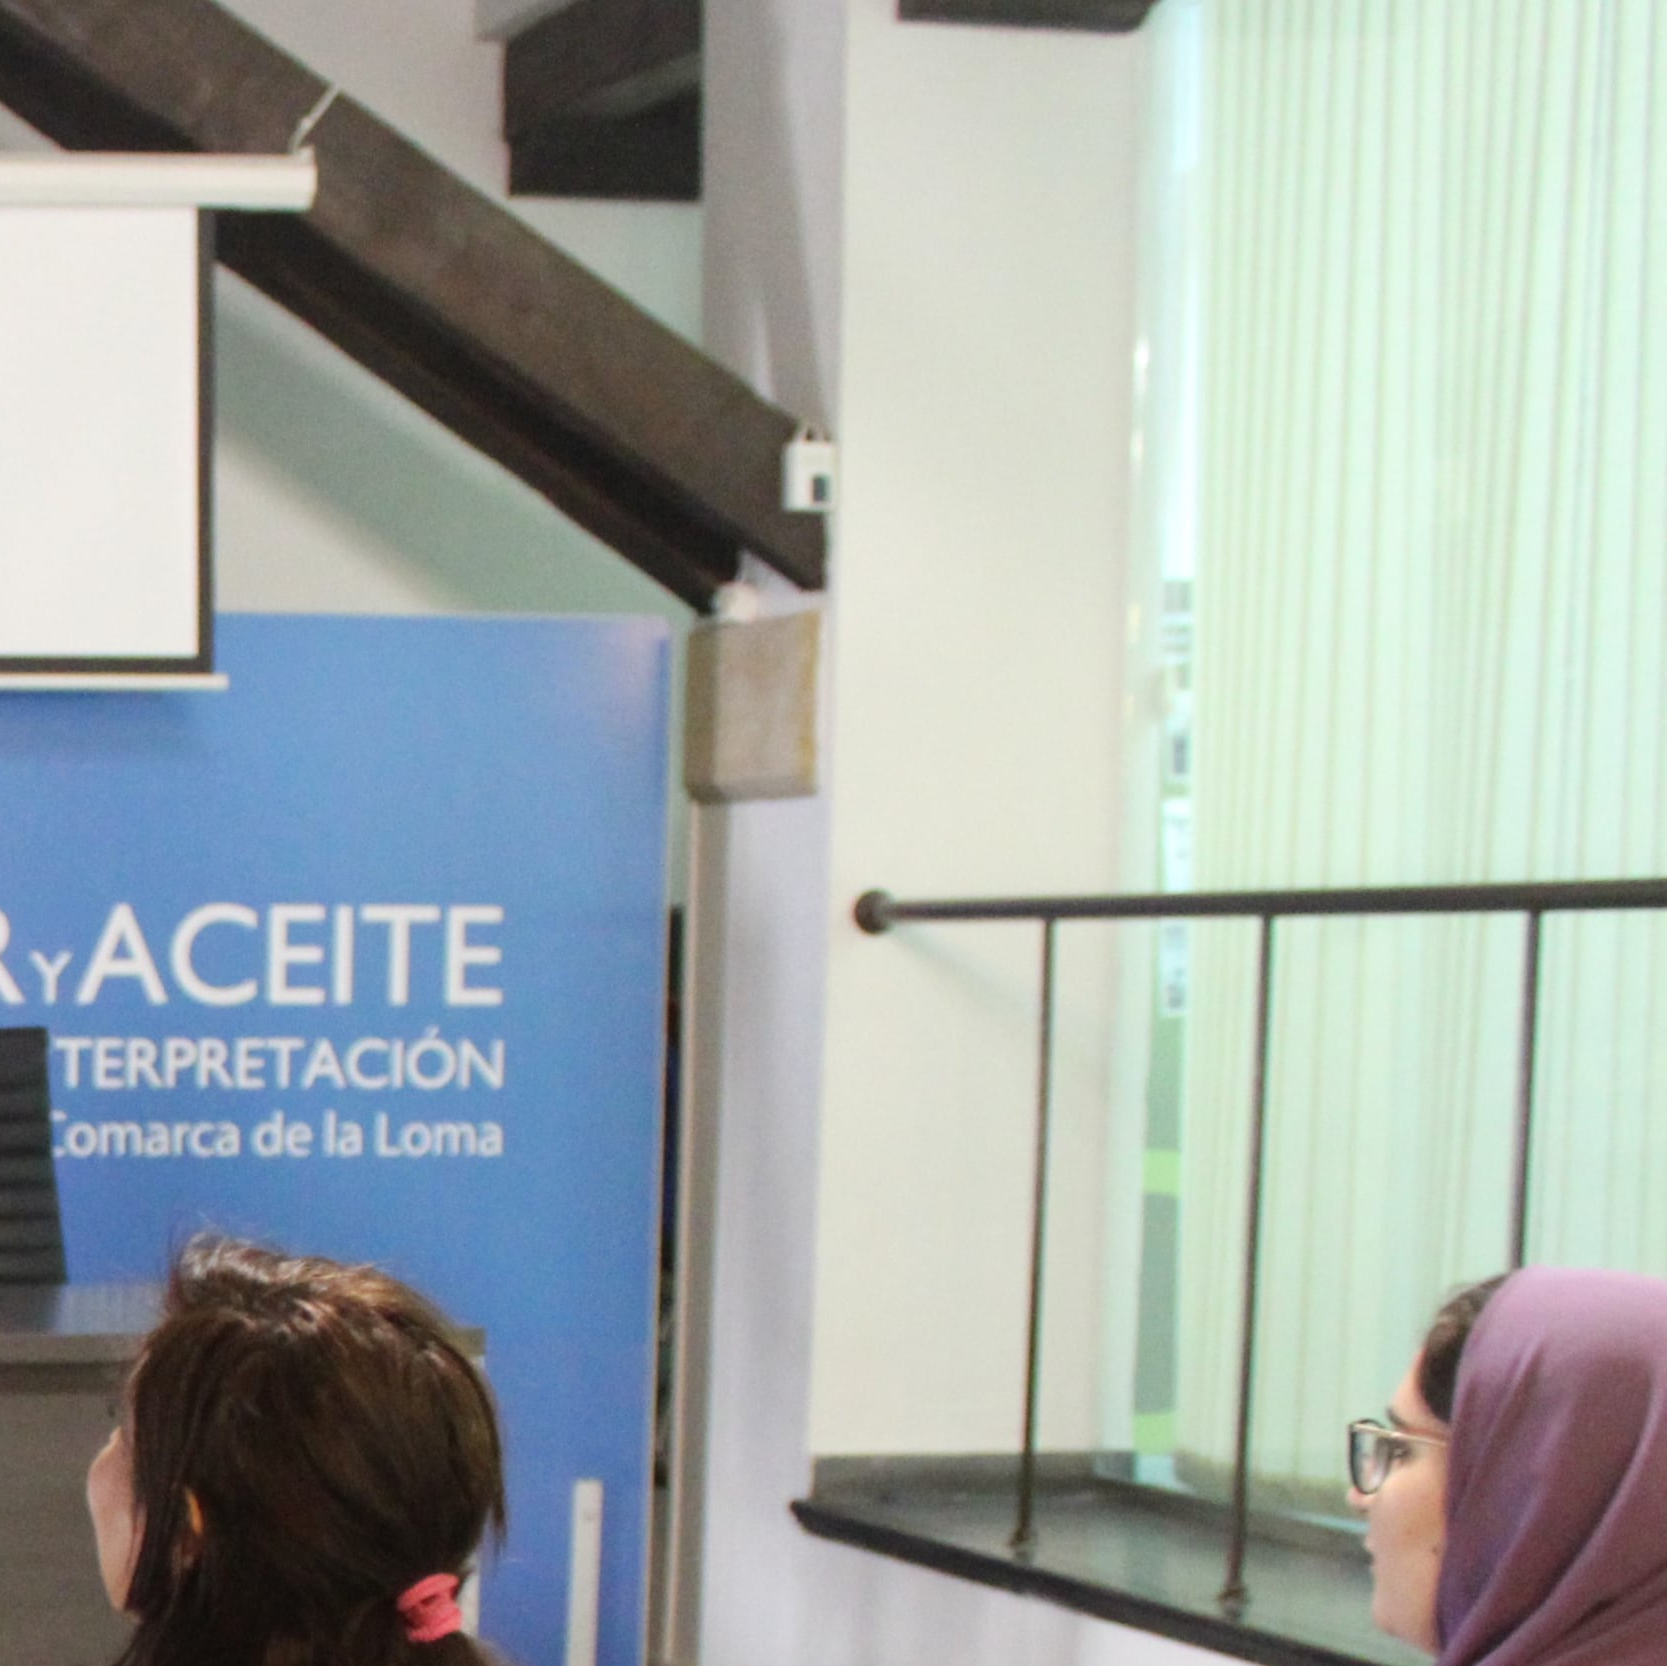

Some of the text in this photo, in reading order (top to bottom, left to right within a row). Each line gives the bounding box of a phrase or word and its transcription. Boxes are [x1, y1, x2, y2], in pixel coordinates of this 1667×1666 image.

[76, 902, 504, 1006] ACEITE
[53, 1026, 505, 1090] TERPRETACIÓN
[251, 1110, 312, 1158] de
[323, 1109, 363, 1157] la
[377, 1112, 503, 1157] Loma
